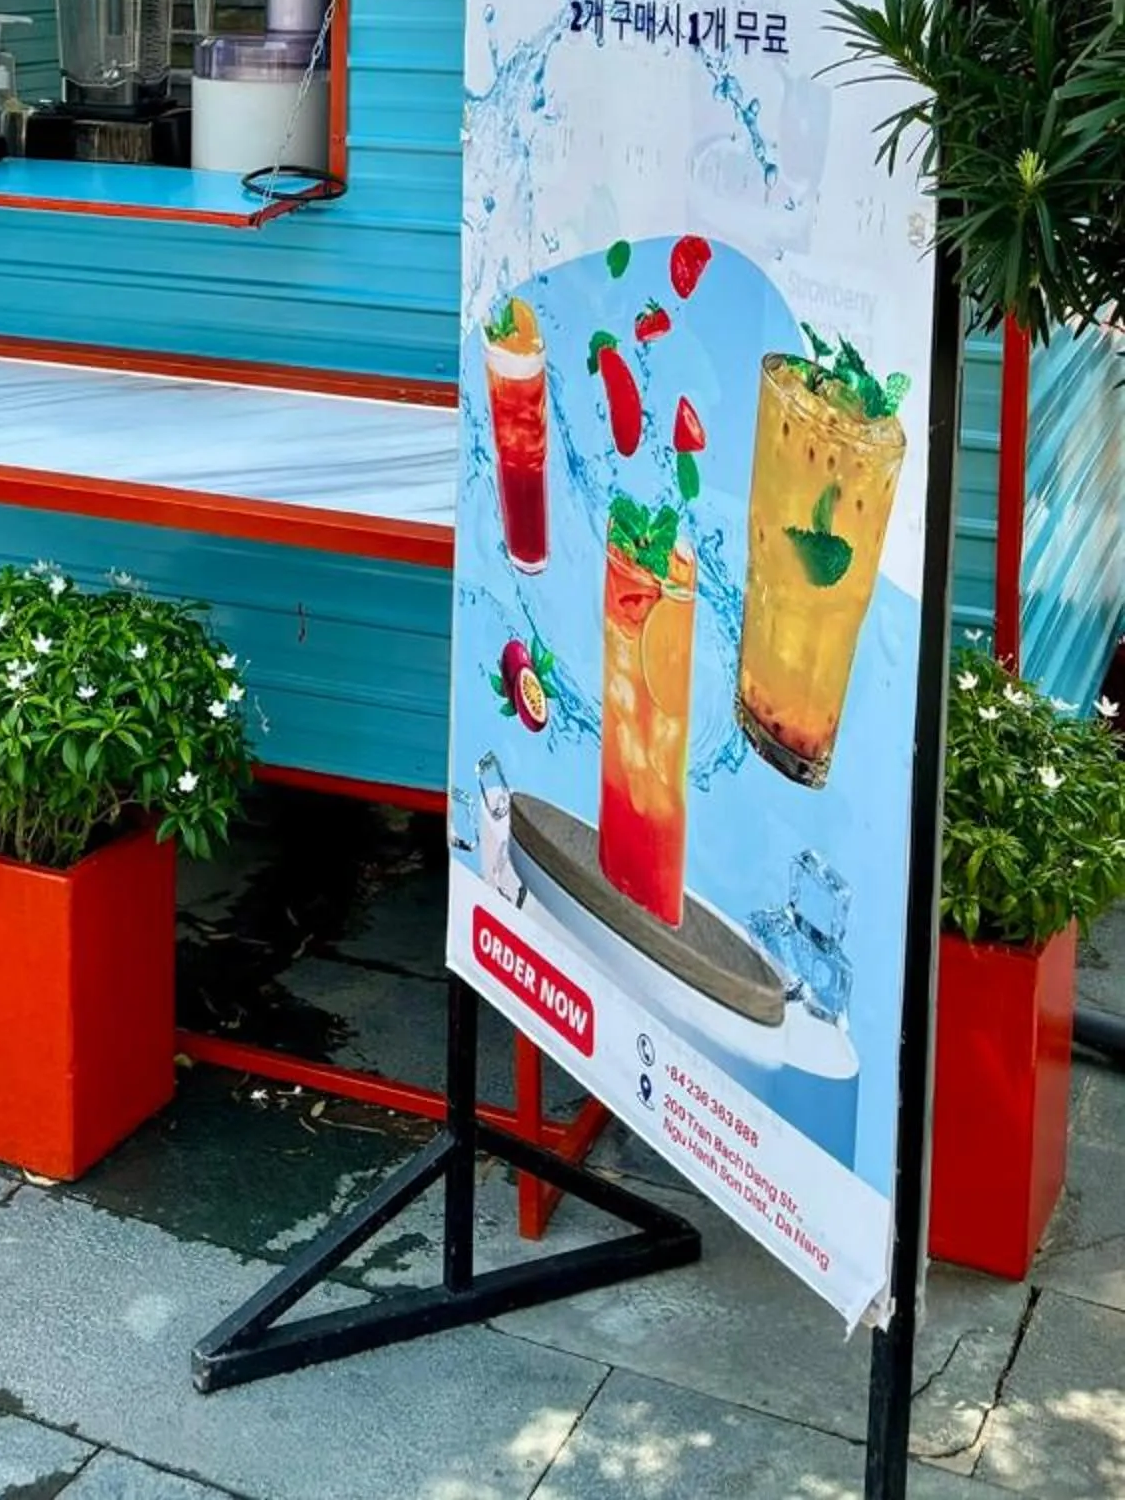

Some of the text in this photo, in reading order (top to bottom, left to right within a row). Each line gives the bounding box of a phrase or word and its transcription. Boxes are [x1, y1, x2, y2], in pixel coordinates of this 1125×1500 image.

[734, 10, 790, 55] 무료
[479, 927, 588, 1037] ORDER NOW
[663, 1115, 687, 1147] Ngu
[719, 1164, 743, 1195] Son
[775, 1212, 793, 1238] Da
[794, 1230, 831, 1273] Nang
[664, 1093, 686, 1122] 200
[687, 1111, 713, 1147] Tran
[714, 1135, 744, 1172] Bach
[744, 1160, 778, 1203] Dang
